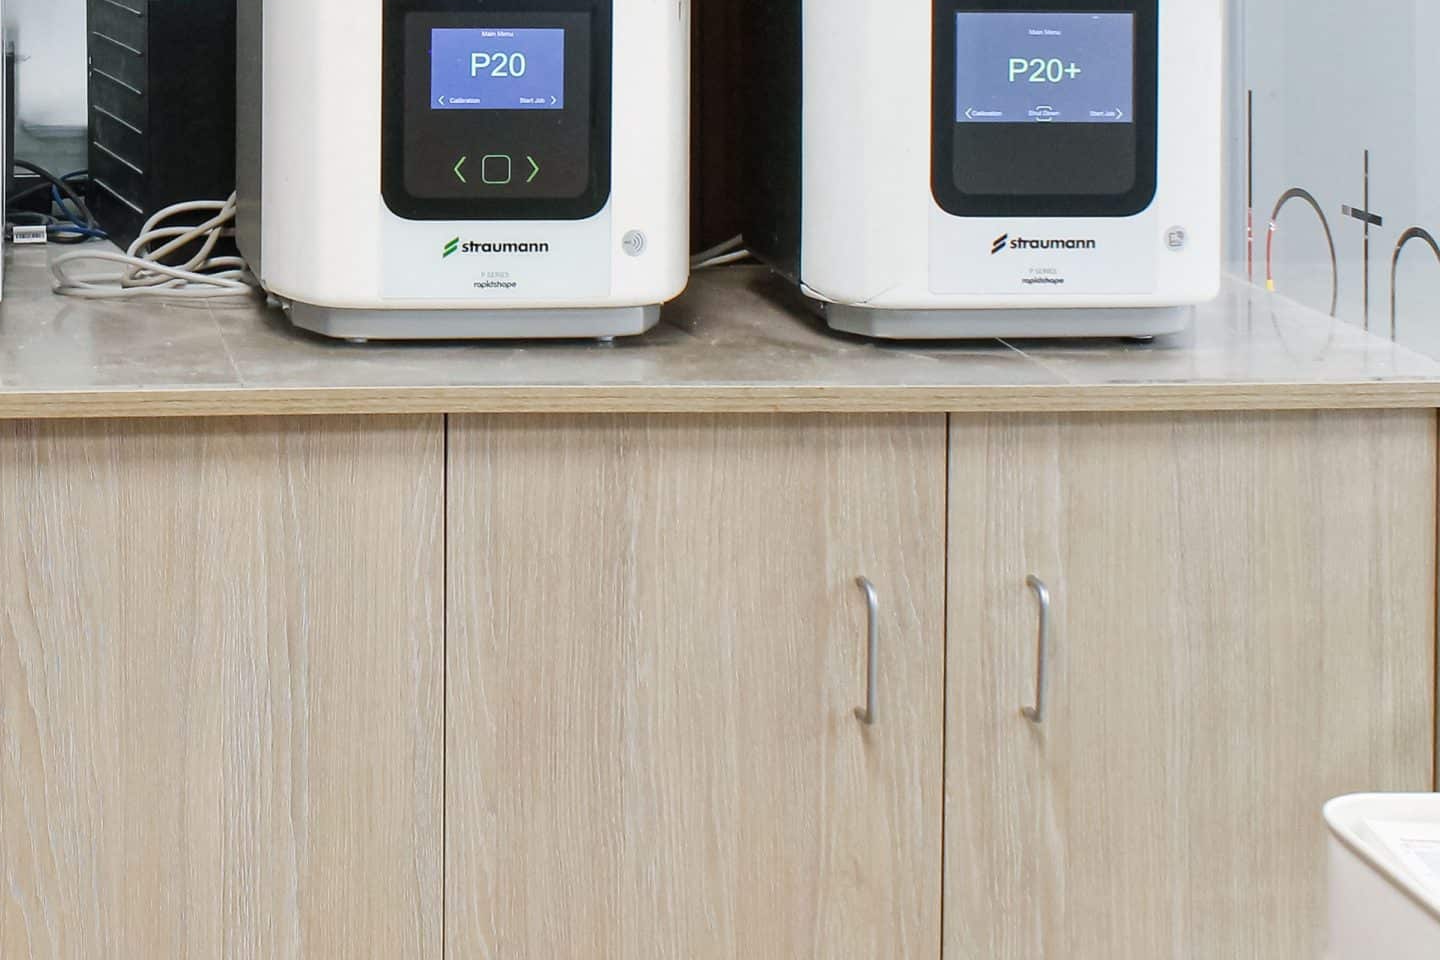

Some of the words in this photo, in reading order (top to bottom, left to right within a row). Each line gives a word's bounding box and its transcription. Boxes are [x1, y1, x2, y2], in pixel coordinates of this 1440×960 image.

[471, 52, 526, 77] P20
[1009, 58, 1081, 83] P20+
[462, 240, 549, 253] straumann
[1009, 236, 1096, 249] straumann
